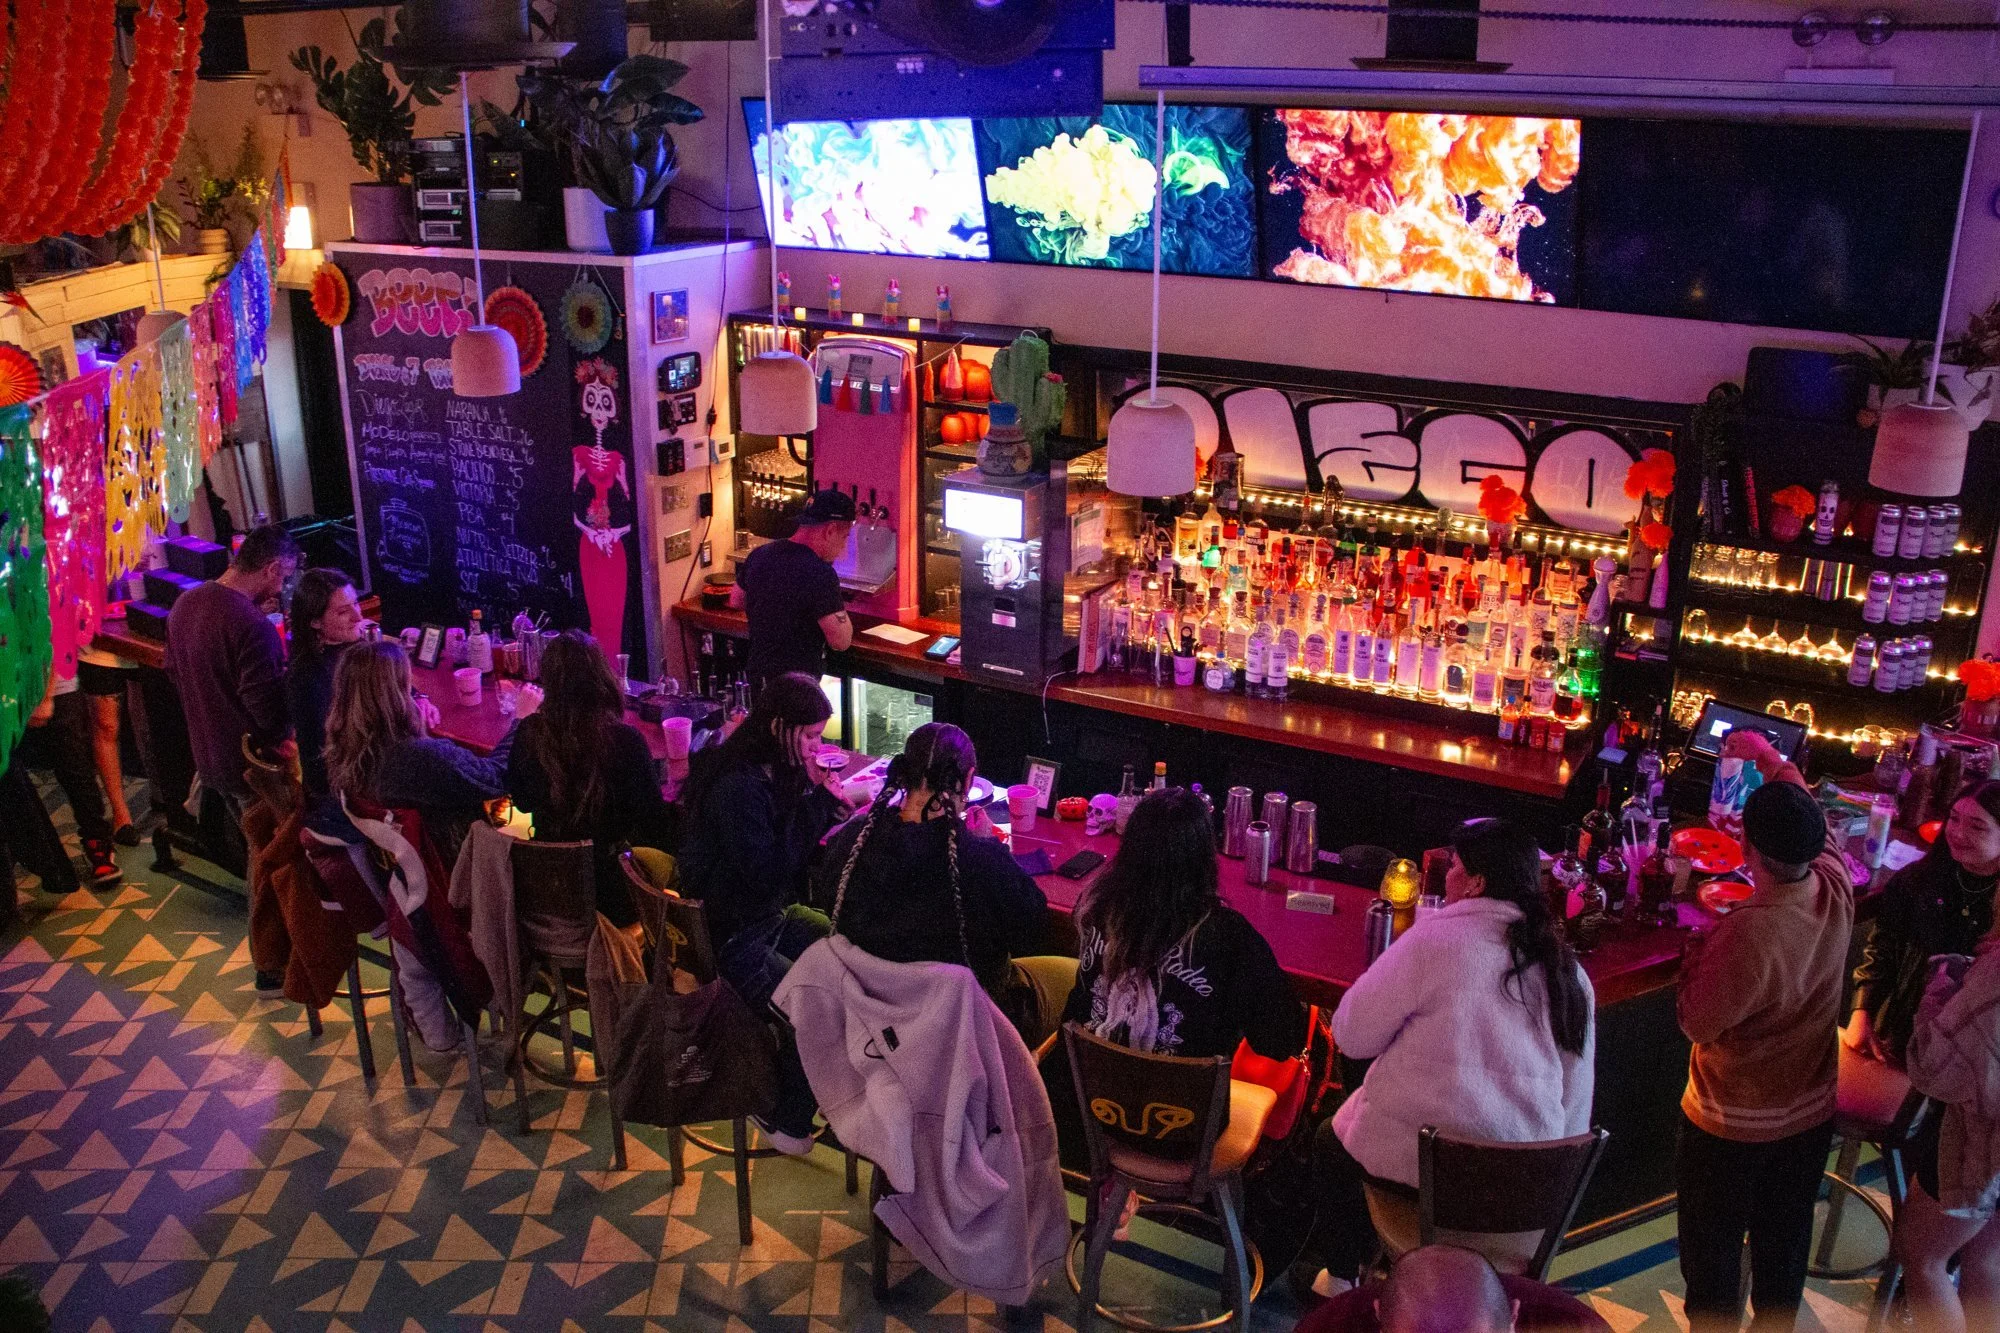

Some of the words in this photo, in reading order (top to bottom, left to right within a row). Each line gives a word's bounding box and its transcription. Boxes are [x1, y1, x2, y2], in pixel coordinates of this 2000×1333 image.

[362, 422, 410, 441] MODELO
[446, 420, 485, 439] TABLE
[488, 424, 513, 442] SALT
